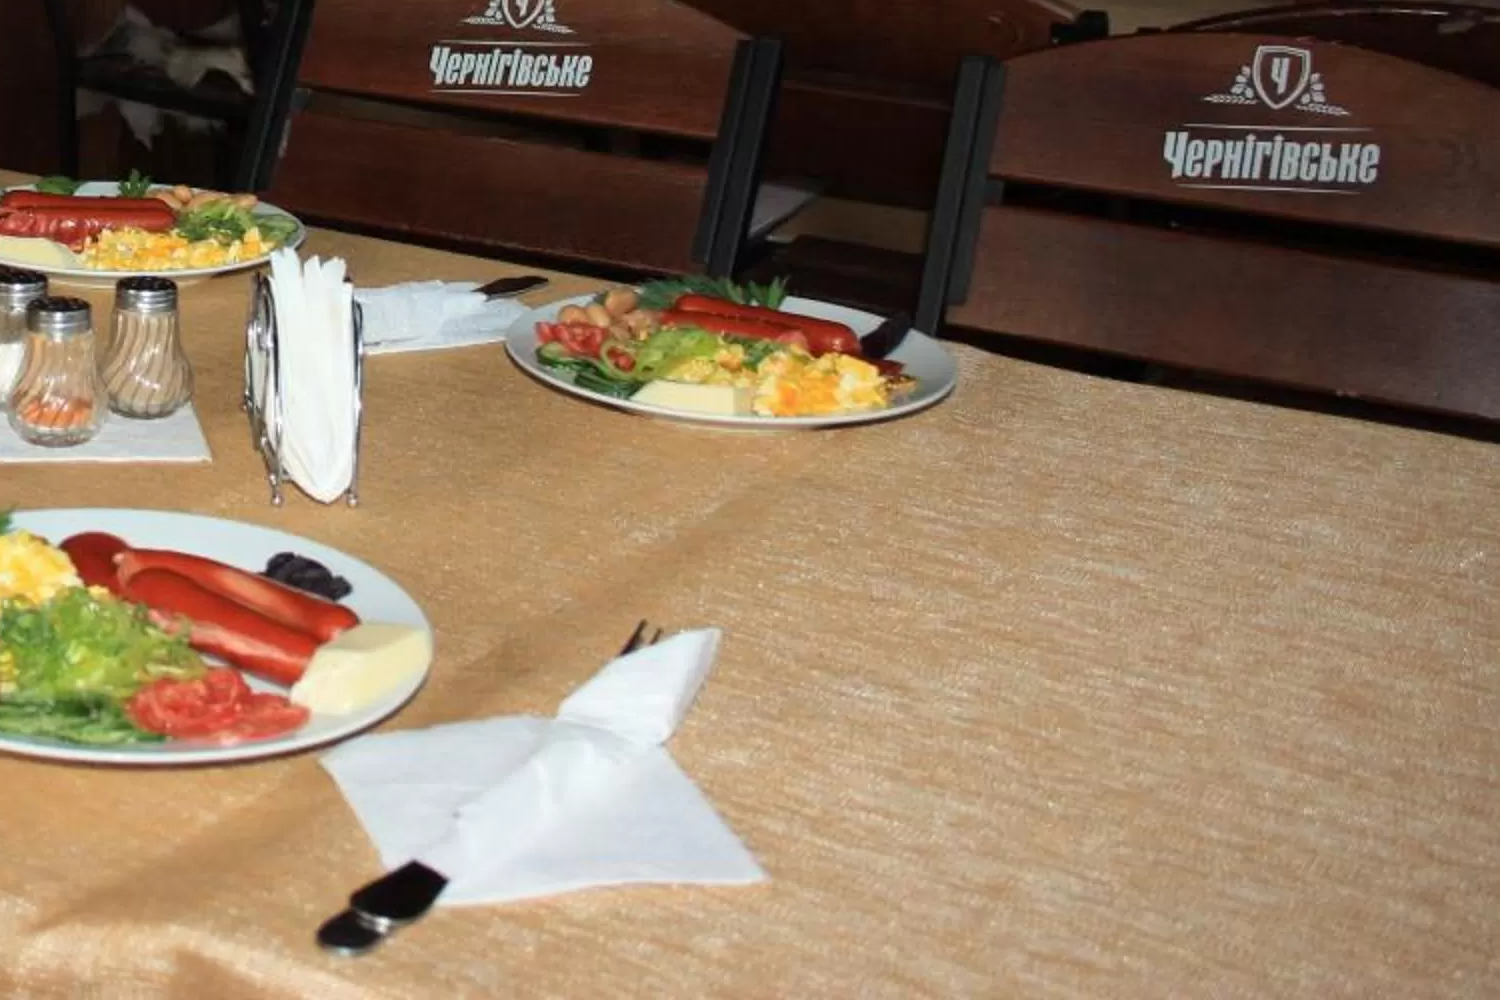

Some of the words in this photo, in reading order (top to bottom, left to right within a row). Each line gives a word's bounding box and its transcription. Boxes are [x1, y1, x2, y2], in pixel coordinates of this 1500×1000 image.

[430, 46, 593, 87] Чернігівське
[1271, 57, 1290, 95] Ч
[1163, 131, 1381, 183] Чернігівське
